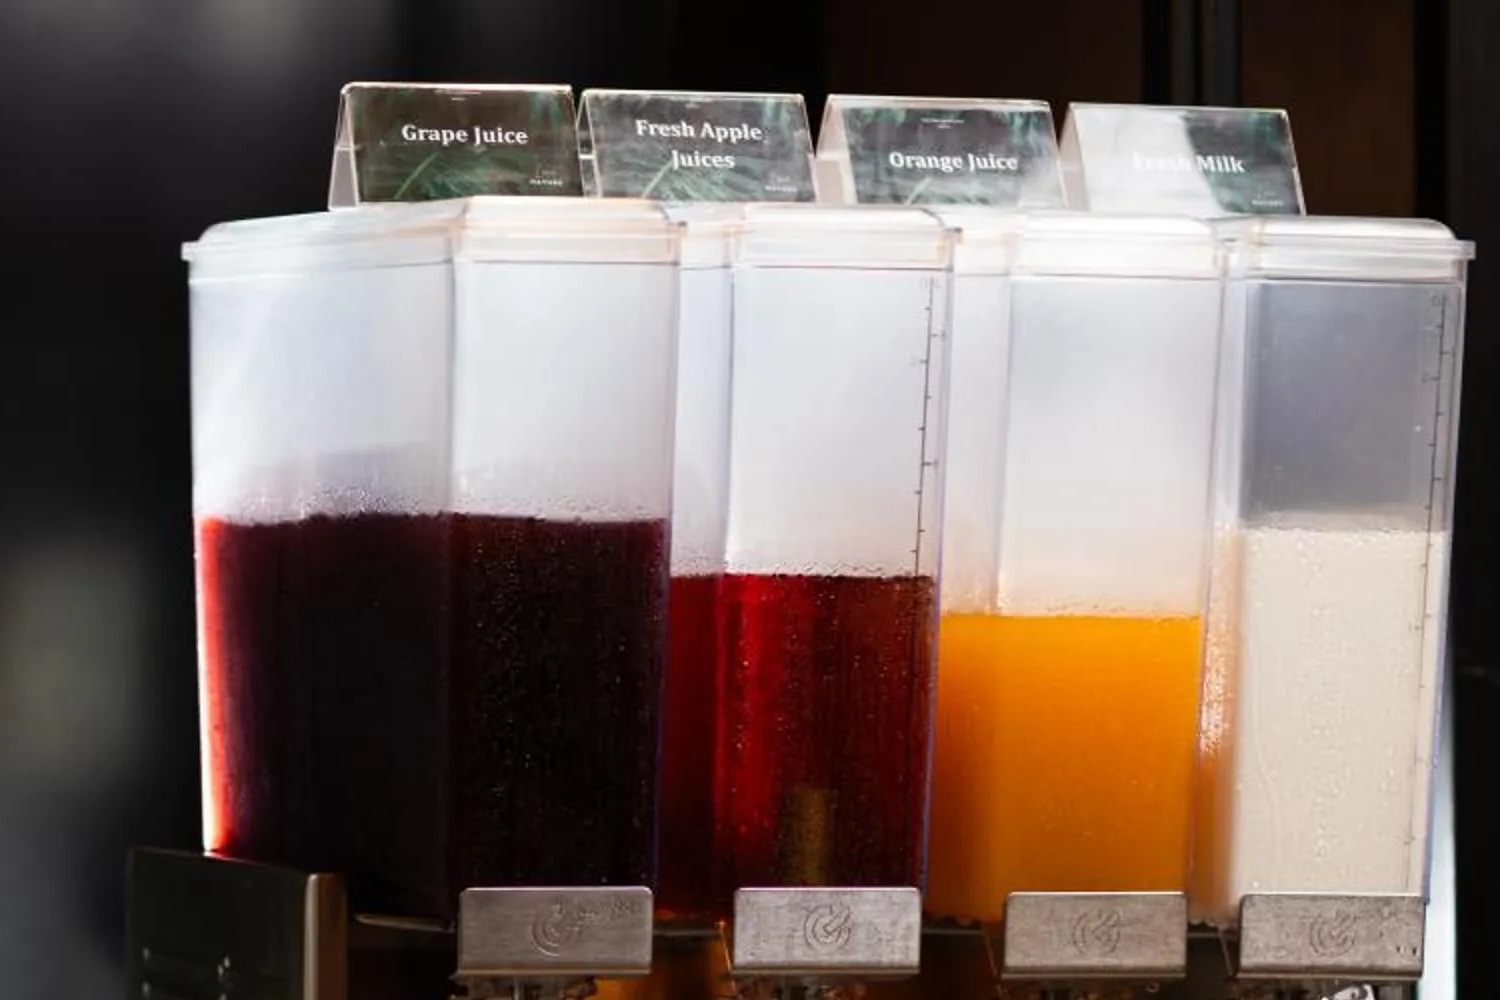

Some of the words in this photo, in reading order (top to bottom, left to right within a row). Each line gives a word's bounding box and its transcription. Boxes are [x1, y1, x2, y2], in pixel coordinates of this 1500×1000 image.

[401, 124, 469, 146] Grape
[473, 126, 529, 146] Juice
[635, 119, 696, 138] Fresh
[700, 121, 763, 144] Apple
[671, 149, 736, 171] Juices
[889, 151, 963, 173] Orange
[967, 153, 1018, 172] Juice
[1196, 155, 1246, 173] Milk
